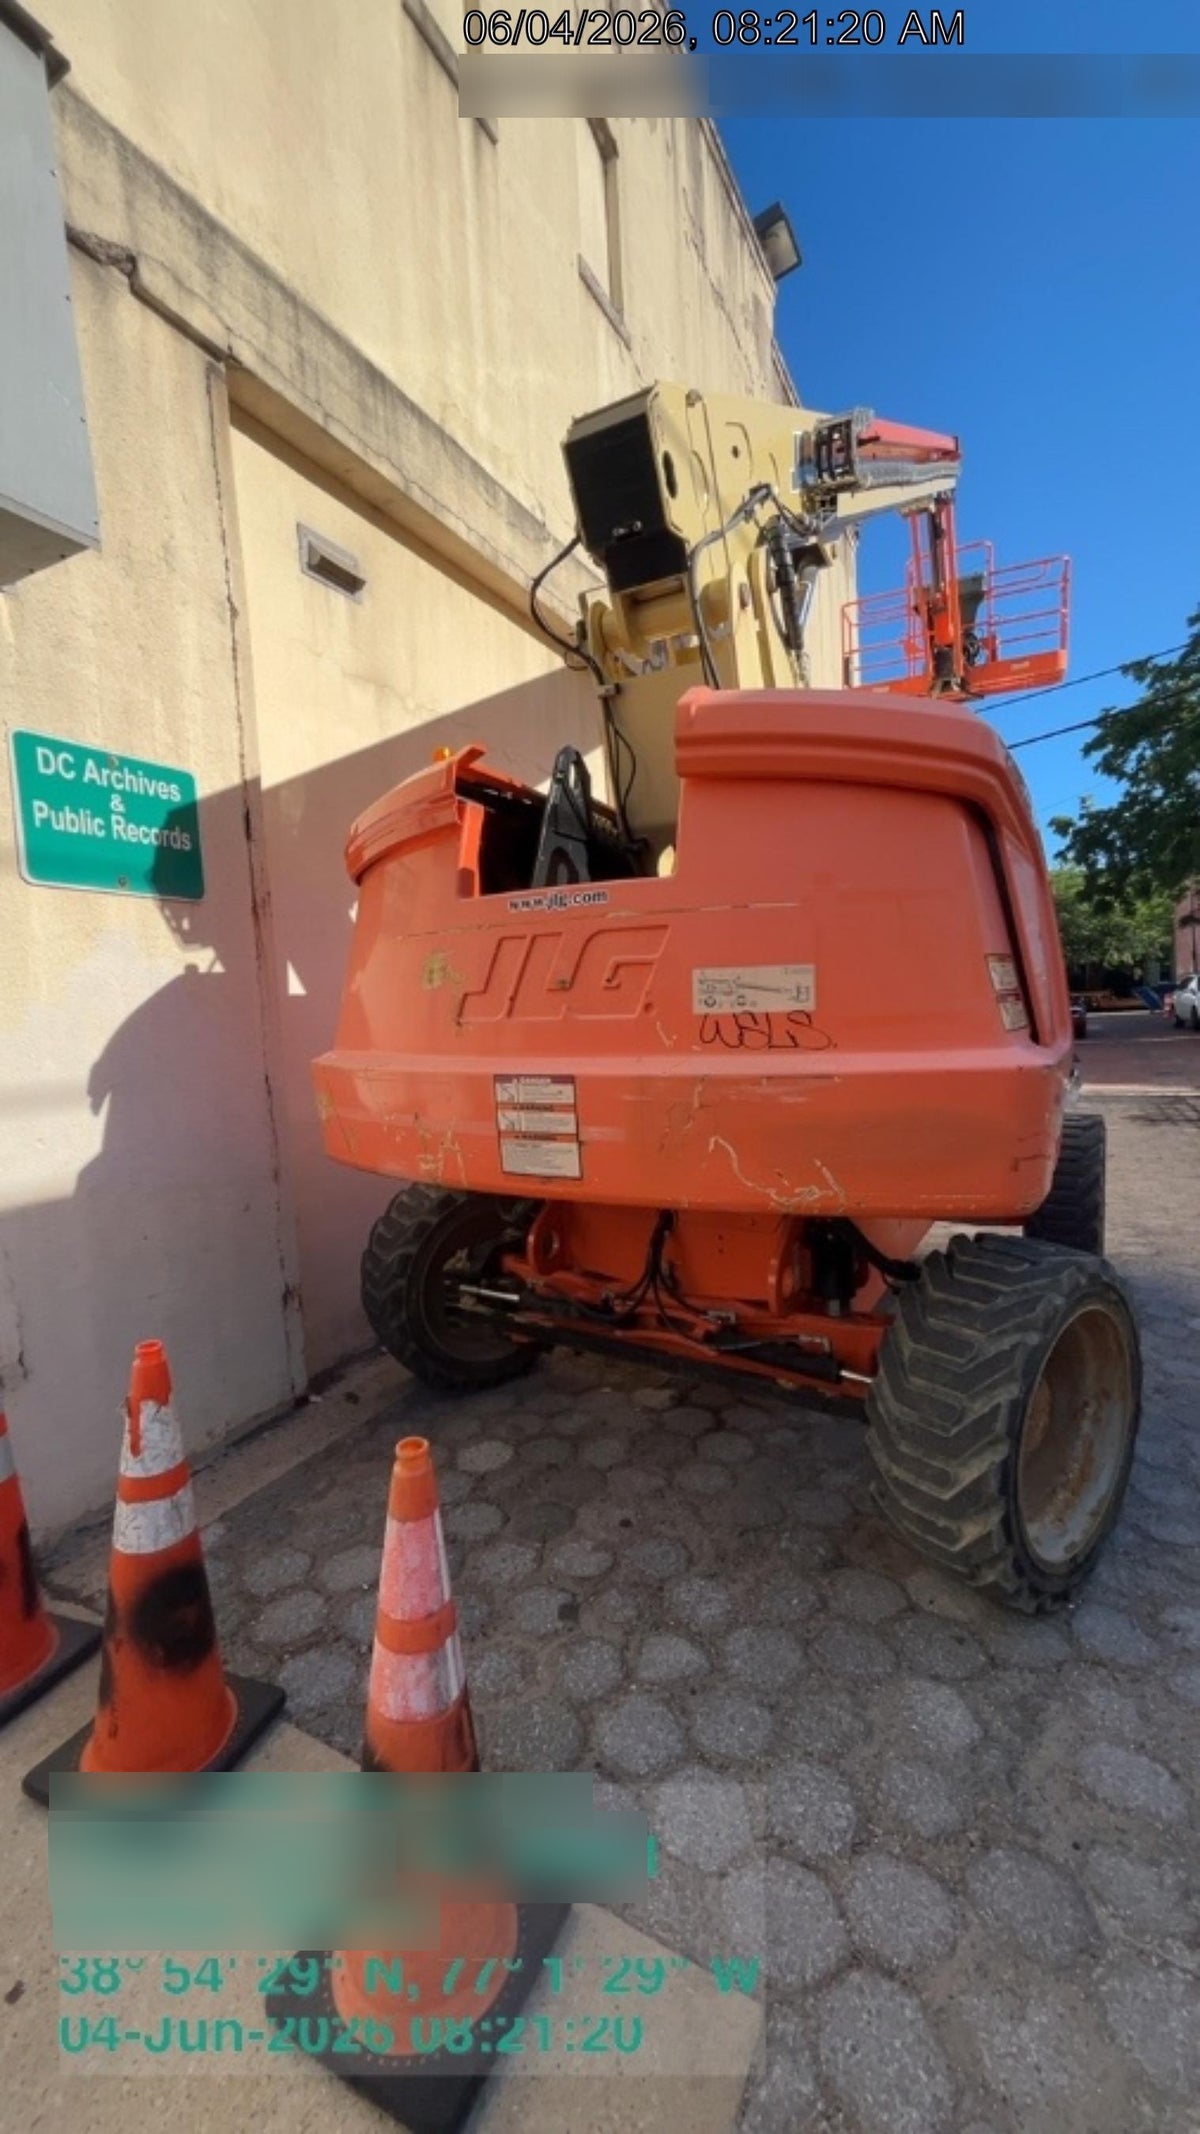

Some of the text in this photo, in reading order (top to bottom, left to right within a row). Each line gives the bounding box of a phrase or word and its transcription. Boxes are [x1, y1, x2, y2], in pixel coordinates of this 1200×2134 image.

[35, 746, 182, 802] DC Archives
[32, 800, 192, 851] Public Records
[109, 794, 126, 814] &
[455, 925, 671, 1022] JLG
